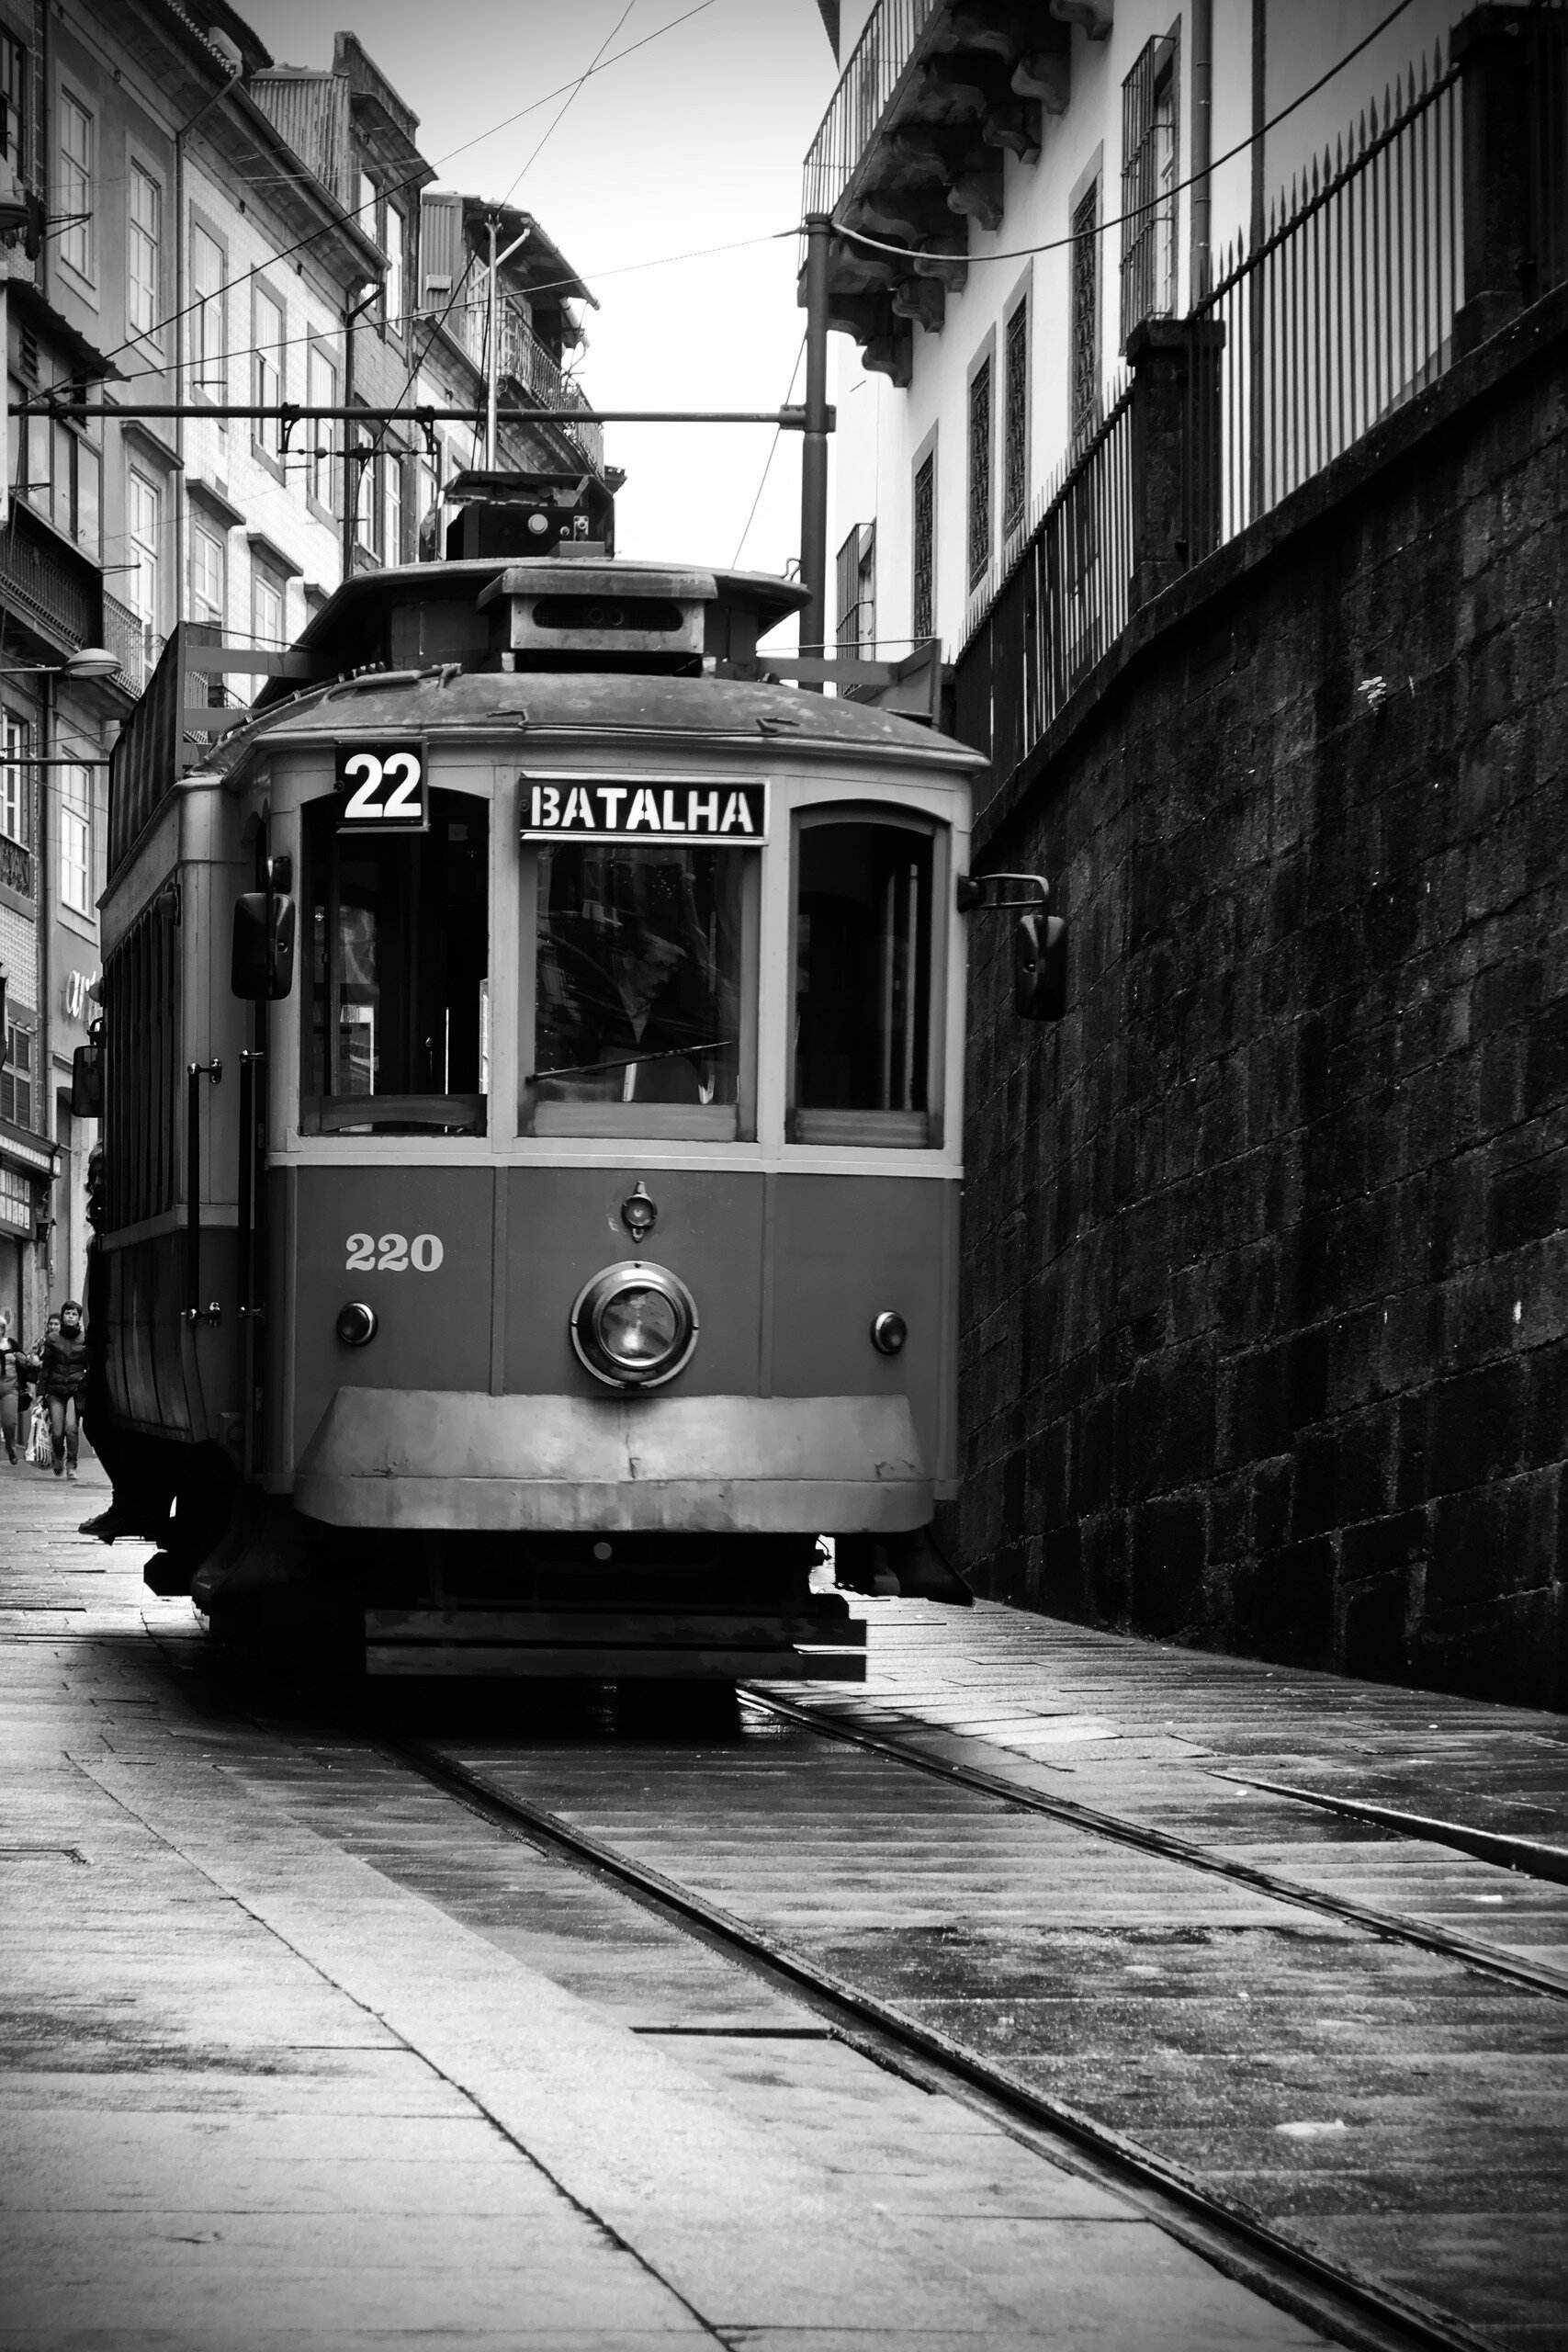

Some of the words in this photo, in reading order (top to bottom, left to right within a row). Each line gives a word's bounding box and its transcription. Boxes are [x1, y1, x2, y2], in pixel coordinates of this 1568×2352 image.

[344, 753, 422, 819] 22
[531, 786, 754, 832] BATALHA
[345, 1233, 445, 1272] 220
